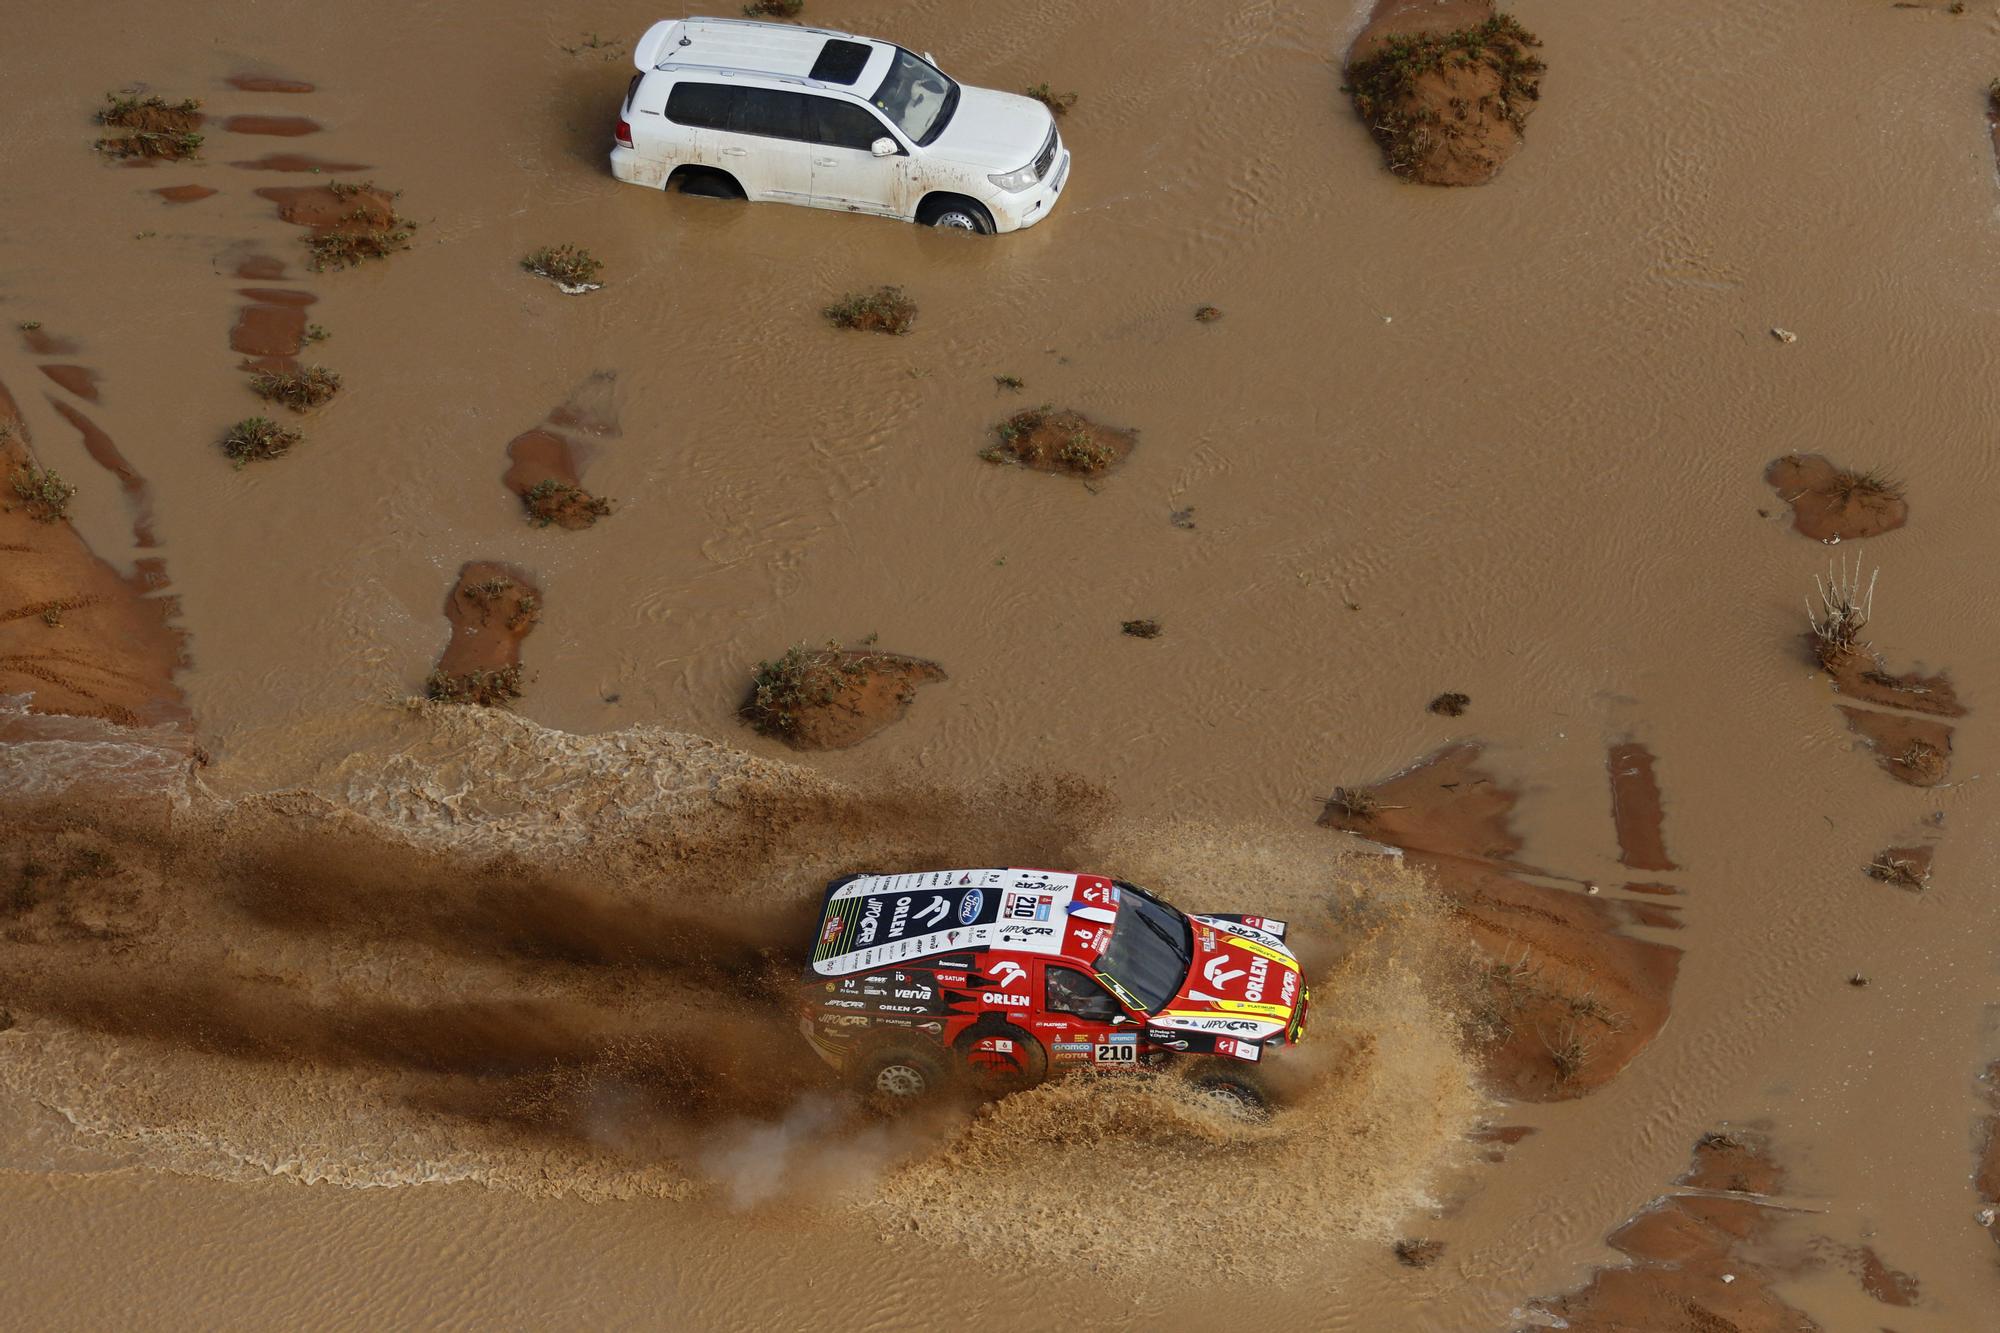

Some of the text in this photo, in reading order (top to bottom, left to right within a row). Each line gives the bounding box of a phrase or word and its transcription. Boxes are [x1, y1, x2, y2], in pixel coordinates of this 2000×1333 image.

[1015, 881, 1069, 892] JIPOCAR
[962, 895, 979, 918] Ford
[1014, 896, 1036, 918] 210
[859, 898, 883, 943] JIPOCAR
[888, 897, 912, 938] ORLEN
[1000, 925, 1053, 936] JIPOCAR
[1228, 925, 1283, 949] JIPOCAR
[1245, 956, 1269, 1001] ORLEN
[895, 989, 932, 1000] verva
[982, 992, 1030, 1007] ORLEN
[879, 1004, 911, 1012] ORLEN
[819, 1013, 869, 1026] JIPOCAR
[1202, 1020, 1258, 1031] JIPOCAR
[1055, 1052, 1089, 1060] MOTUL
[1099, 1045, 1132, 1061] 210
